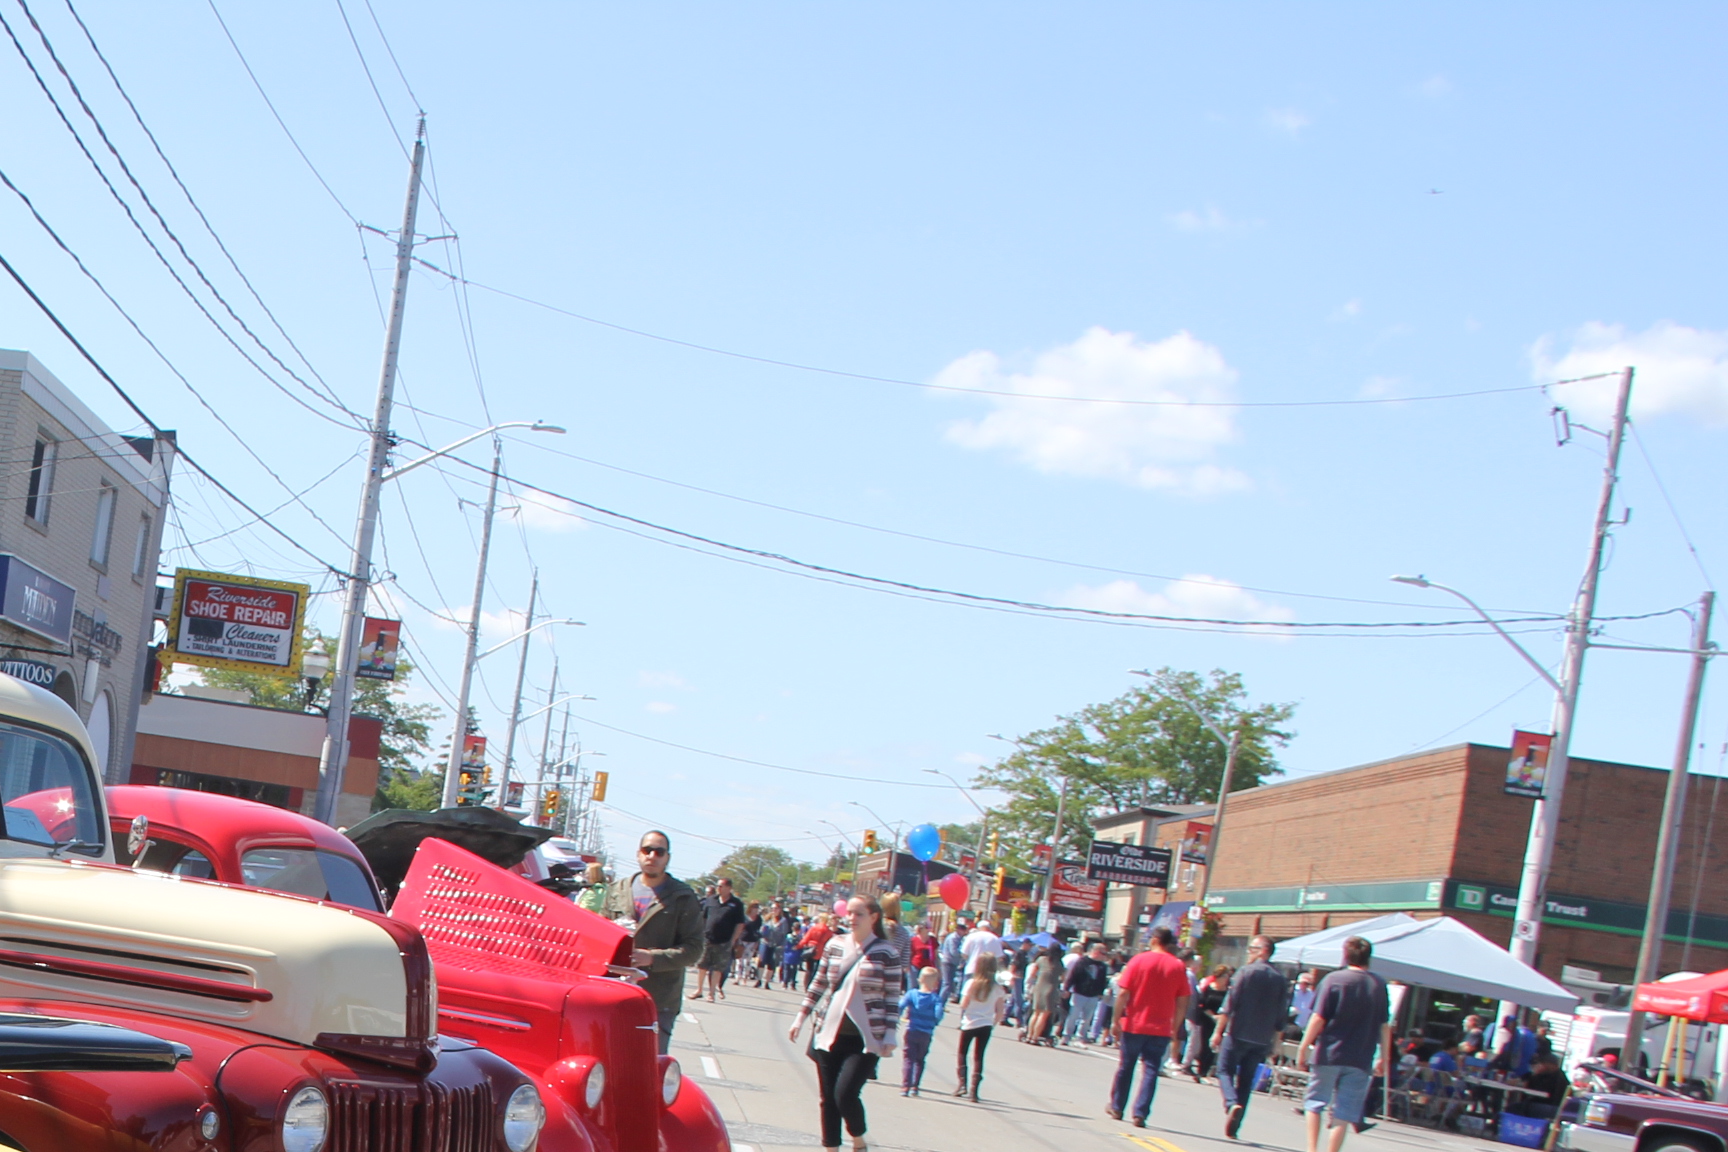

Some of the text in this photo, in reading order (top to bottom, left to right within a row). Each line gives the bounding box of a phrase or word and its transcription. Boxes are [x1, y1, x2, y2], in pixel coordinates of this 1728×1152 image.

[206, 586, 278, 609] Riverside
[189, 600, 287, 626] SHOE REPAIR
[193, 634, 278, 652] SHIRT LAUNDERING
[225, 623, 281, 643] Cleaners
[192, 643, 225, 654] TAILORING
[236, 649, 277, 660] ALTERATIONS
[1091, 853, 1168, 874] RIVERSIDE
[1462, 889, 1481, 905] TD
[1546, 901, 1588, 917] Trust
